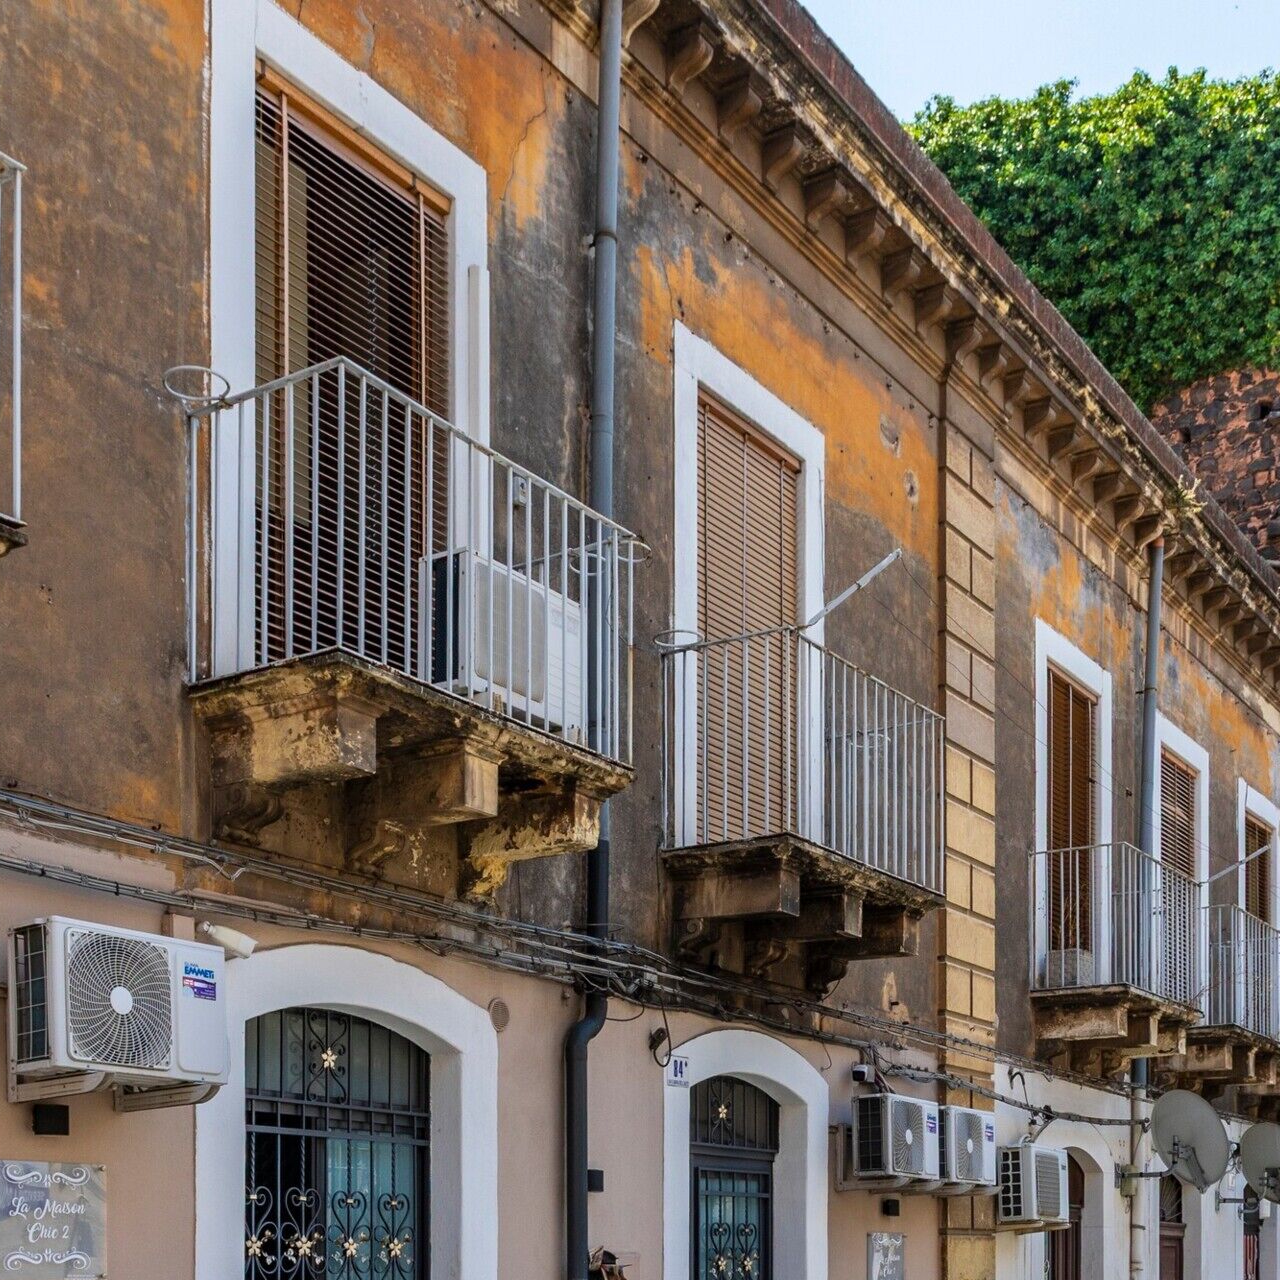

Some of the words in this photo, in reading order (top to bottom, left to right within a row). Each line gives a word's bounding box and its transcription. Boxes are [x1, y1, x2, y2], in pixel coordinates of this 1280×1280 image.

[673, 1059, 684, 1078] 84
[9, 1196, 31, 1219] La
[33, 1199, 86, 1220] Maison
[26, 1222, 60, 1243] Chic
[61, 1225, 71, 1239] 2
